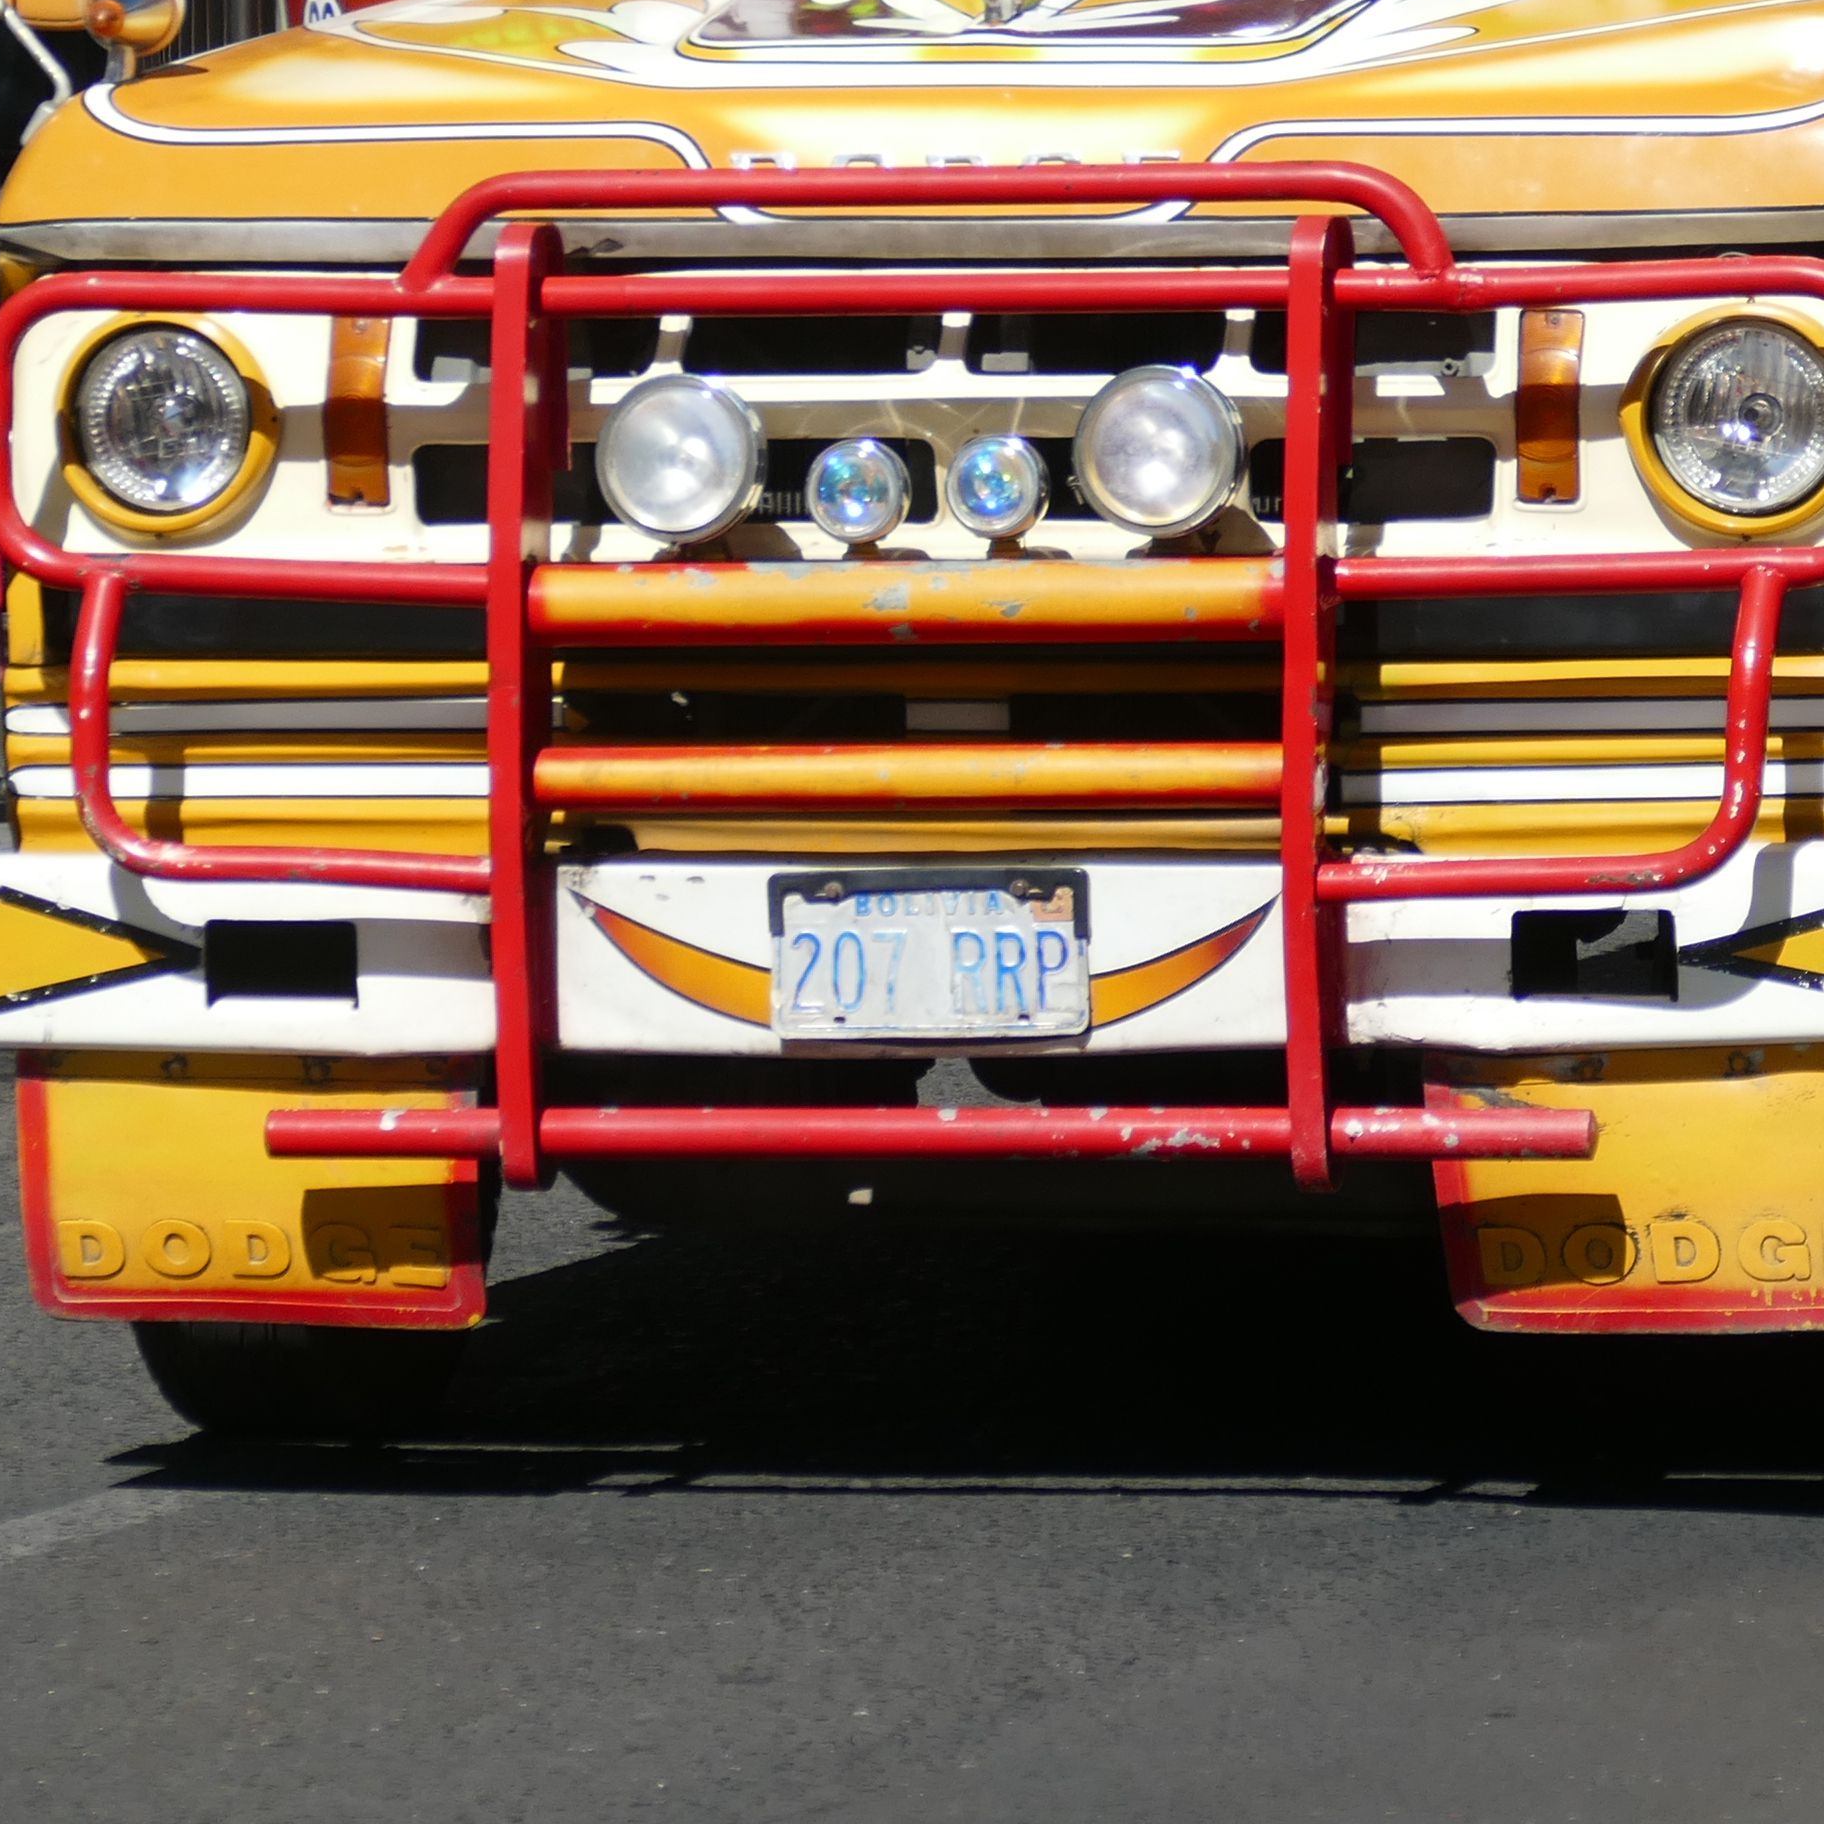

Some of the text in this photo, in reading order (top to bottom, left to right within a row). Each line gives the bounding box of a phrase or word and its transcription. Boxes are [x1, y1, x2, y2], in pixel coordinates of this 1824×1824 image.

[853, 890, 1005, 917] BOLIVIA
[790, 929, 1071, 1016] 207 RRP
[58, 1218, 448, 1289] DODGE
